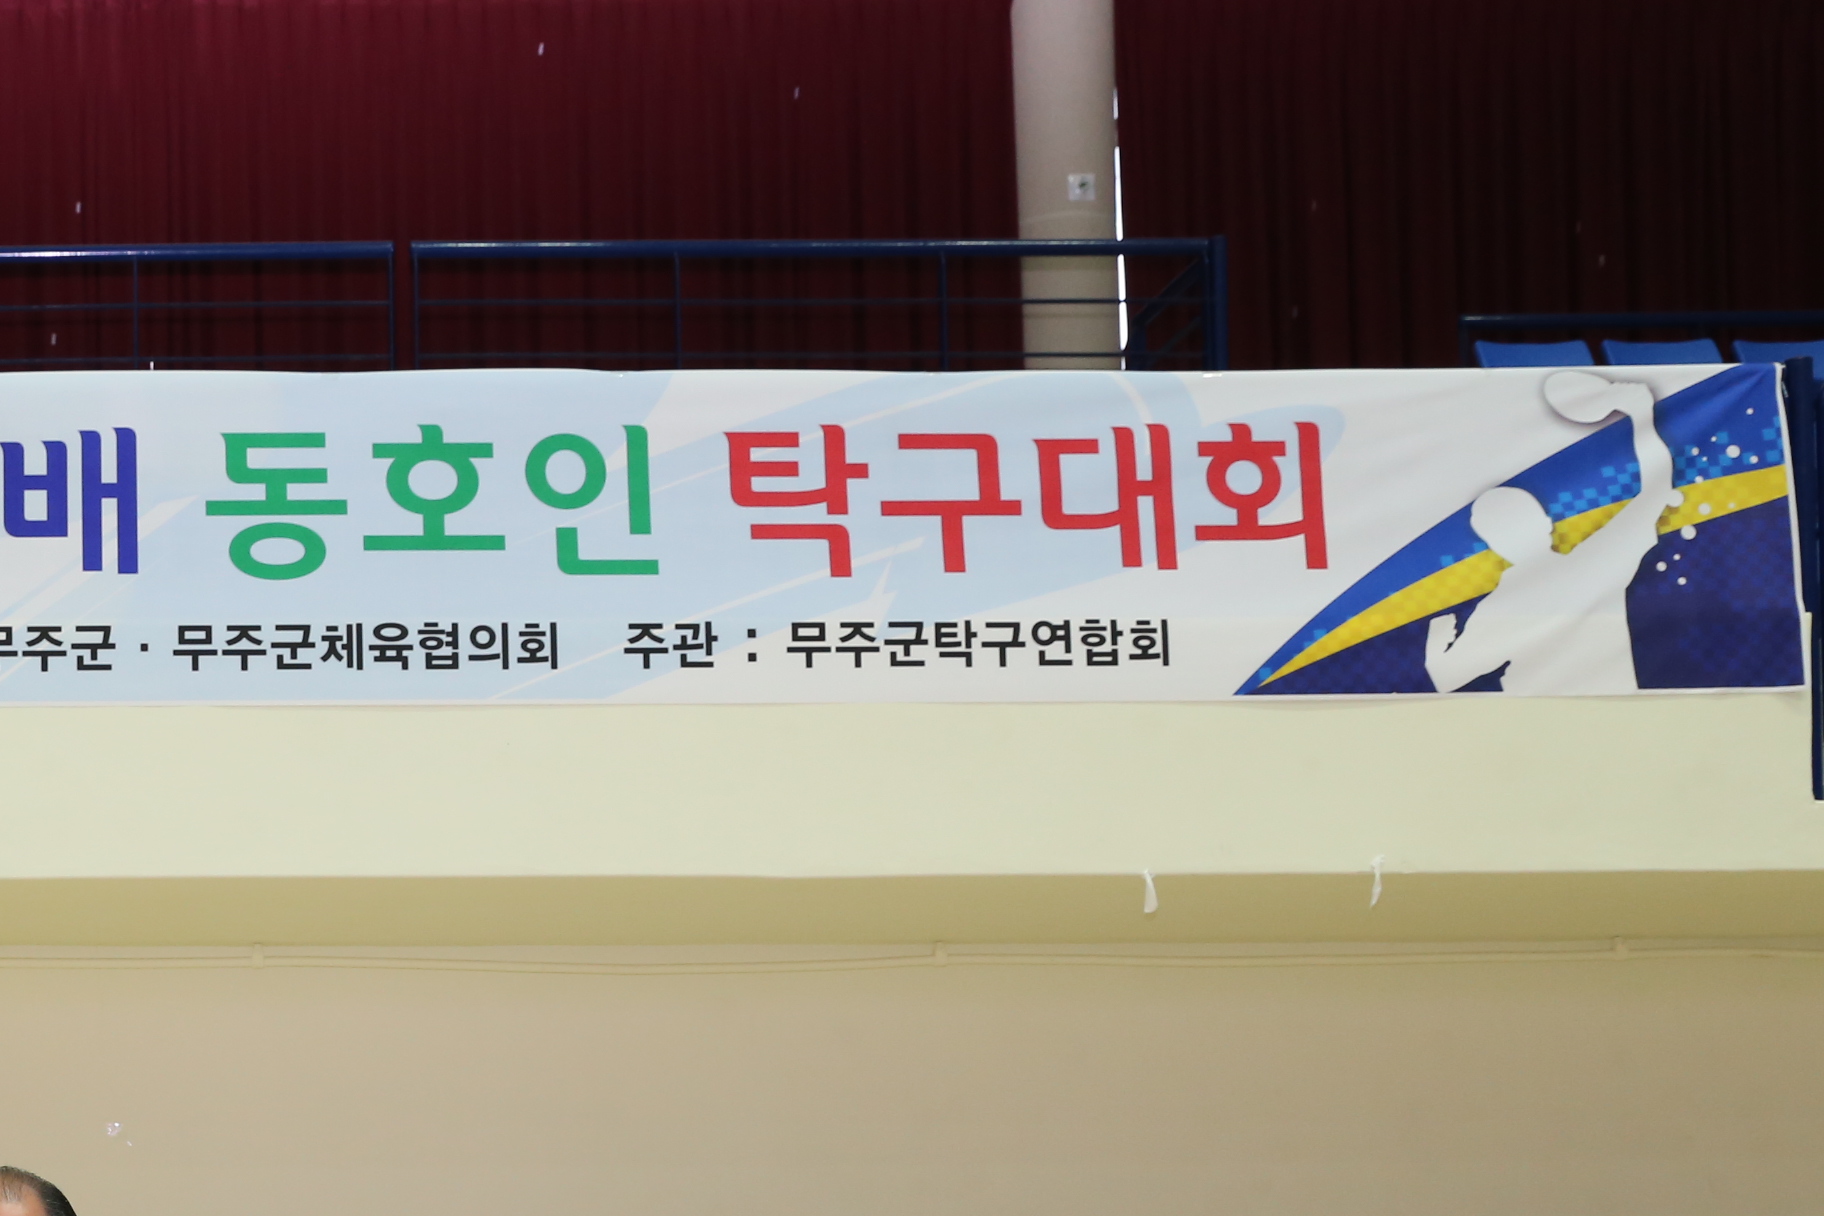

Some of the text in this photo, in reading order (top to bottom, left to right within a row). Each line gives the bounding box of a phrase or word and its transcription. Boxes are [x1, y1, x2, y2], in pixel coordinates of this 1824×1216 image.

[205, 424, 660, 581] 동호인
[723, 421, 1329, 578] 탁구대회
[172, 622, 559, 672] 무주군체육협의회
[786, 619, 1170, 668] 무주군탁구연합회
